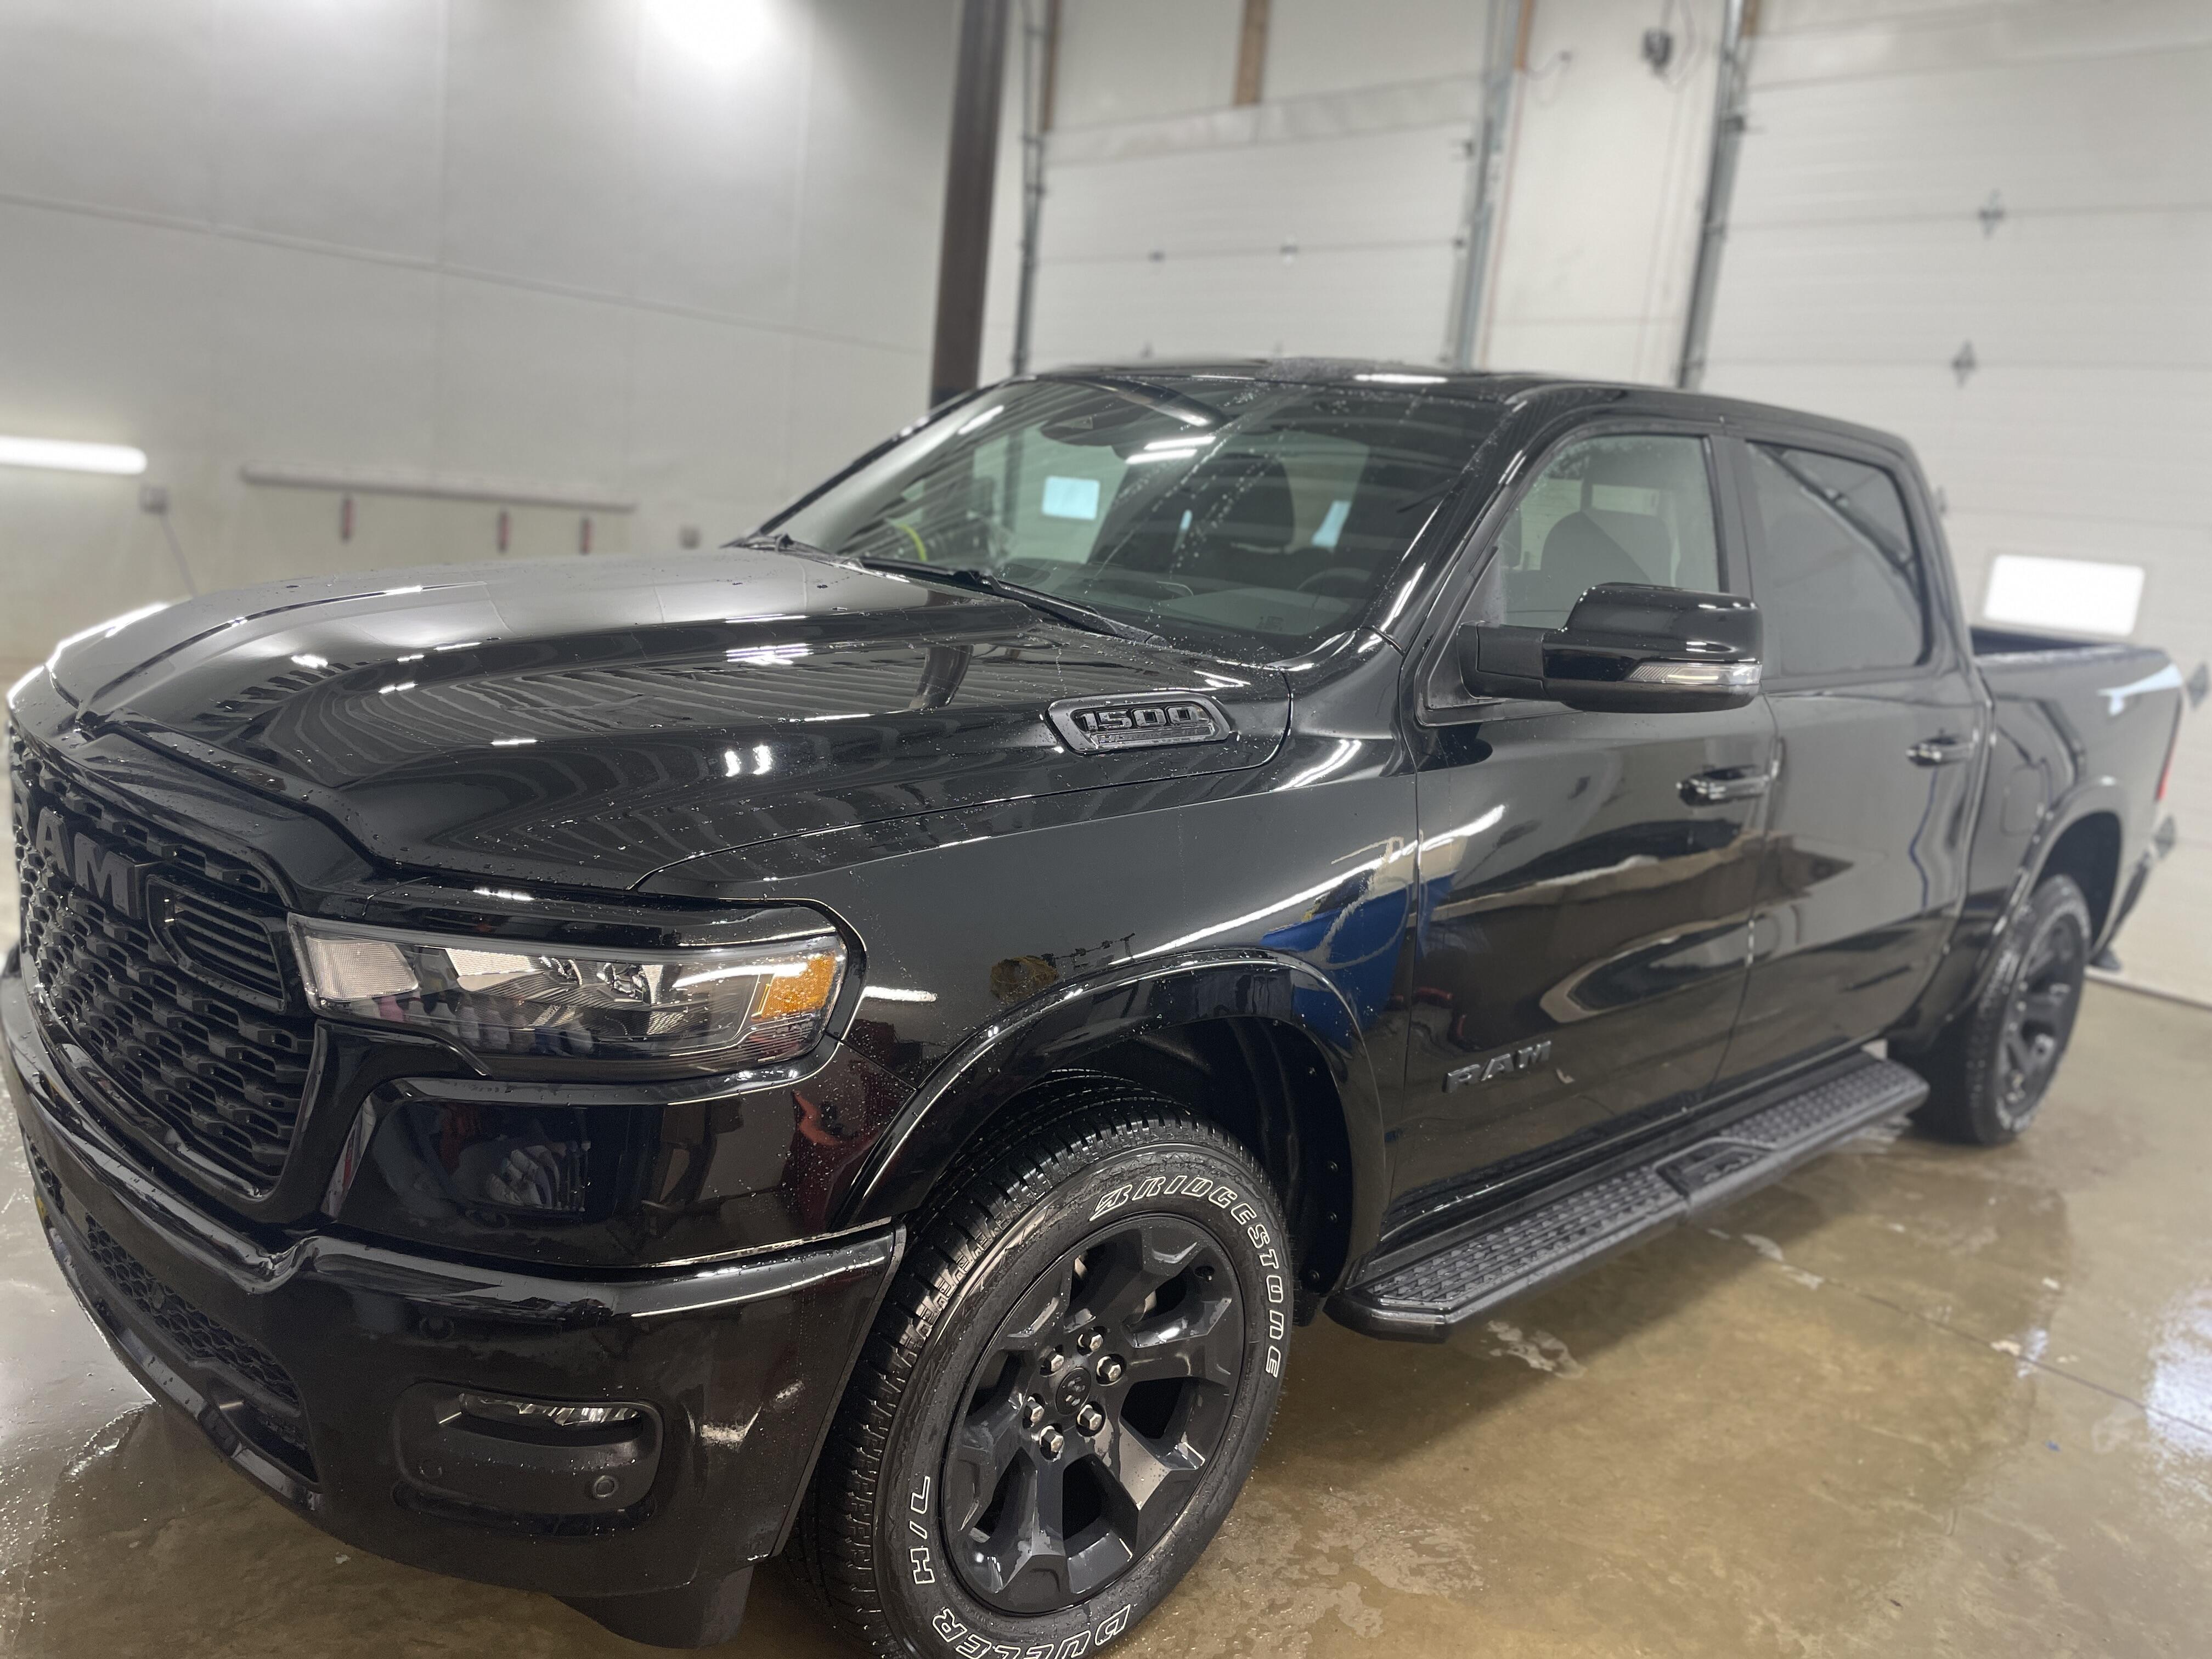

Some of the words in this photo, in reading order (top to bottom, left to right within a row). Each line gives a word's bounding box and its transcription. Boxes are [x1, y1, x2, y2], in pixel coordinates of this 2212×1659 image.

[1075, 705, 1200, 731] 1500
[1442, 1040, 1551, 1093] RAM
[1090, 1175, 1284, 1378] BRIDGESTONE
[909, 1476, 935, 1584] H/L
